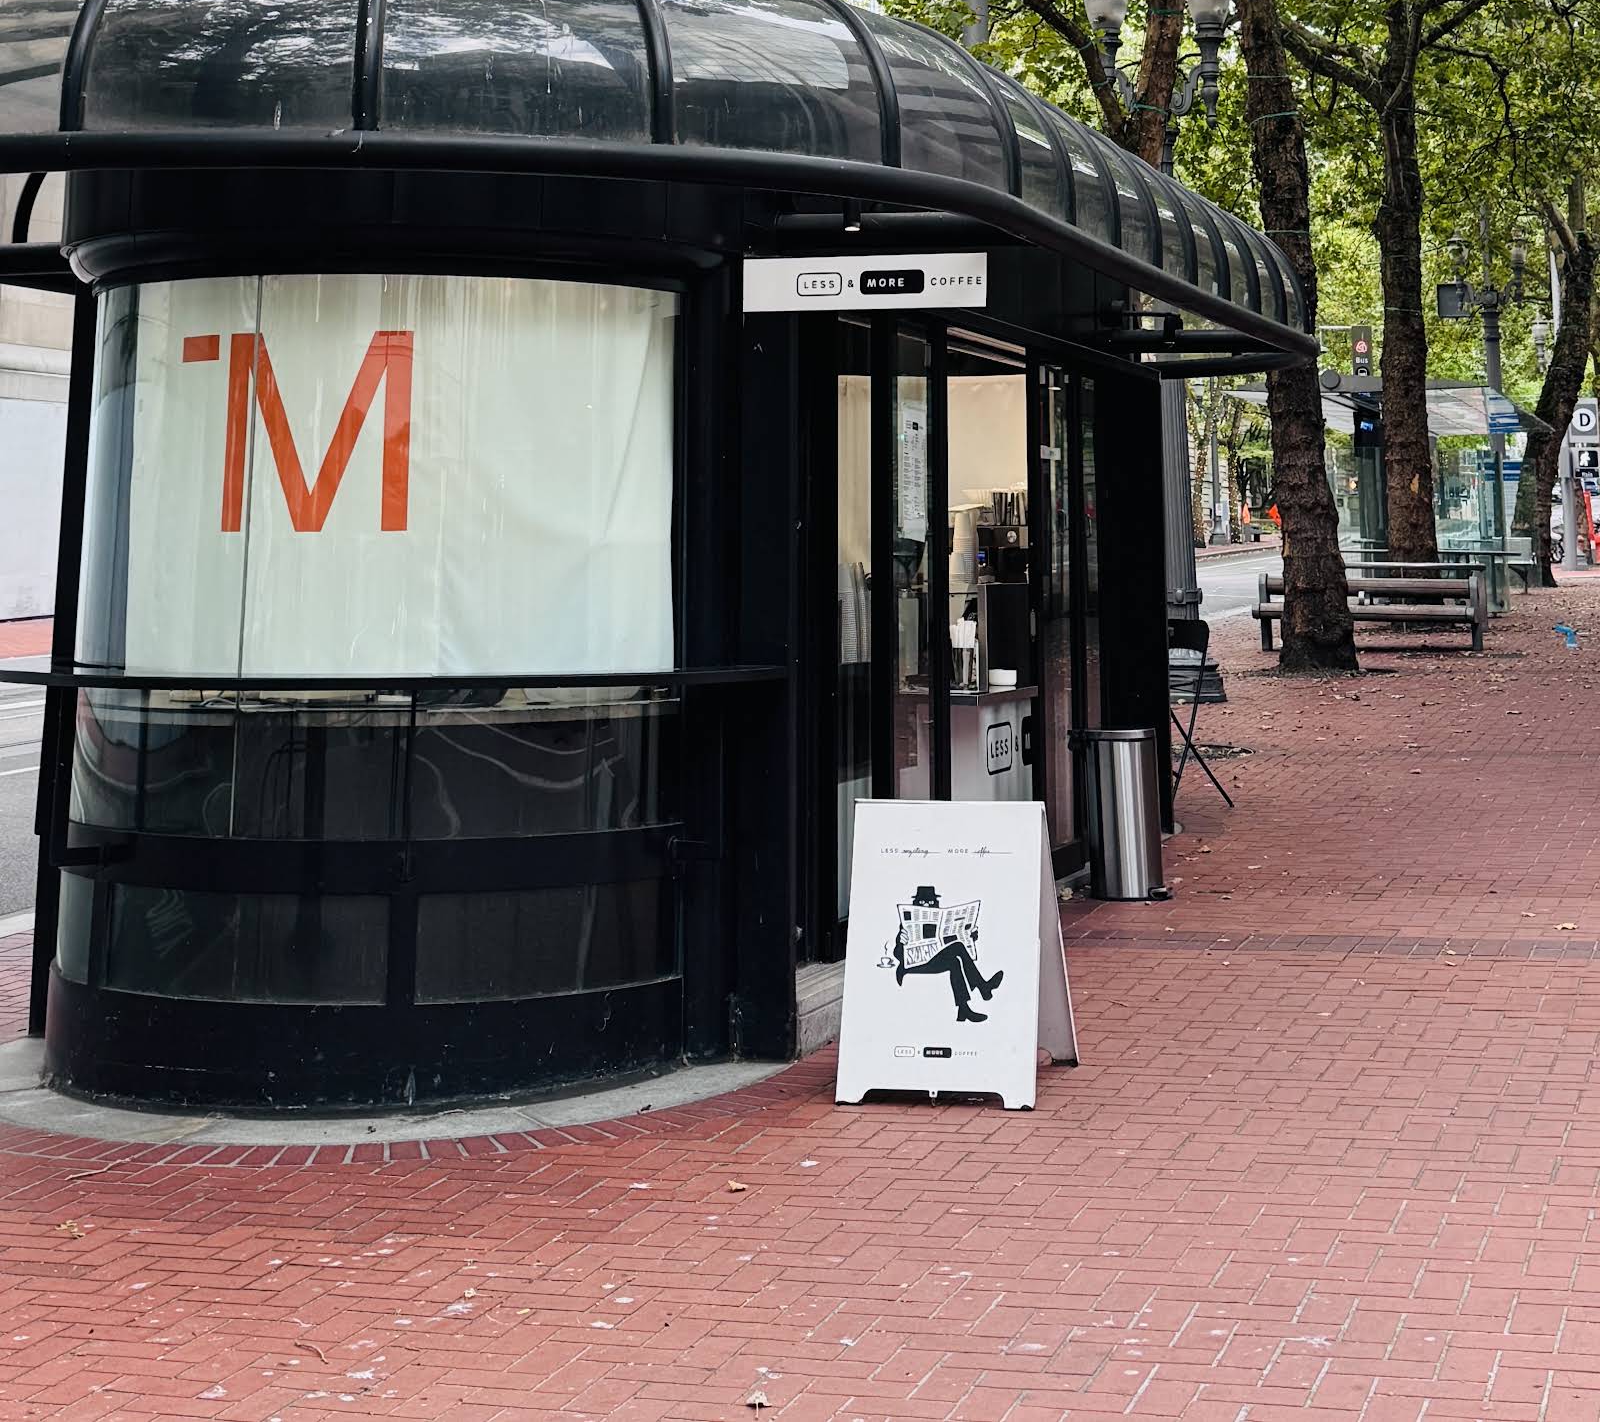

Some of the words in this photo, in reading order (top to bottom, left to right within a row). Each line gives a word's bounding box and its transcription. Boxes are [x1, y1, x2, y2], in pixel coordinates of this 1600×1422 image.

[804, 280, 836, 289] LESS
[847, 279, 854, 288] &
[866, 278, 905, 287] MORE
[930, 276, 983, 286] COFFEE
[1355, 356, 1369, 364] Bus
[1579, 413, 1591, 427] D
[990, 738, 1009, 759] LESS
